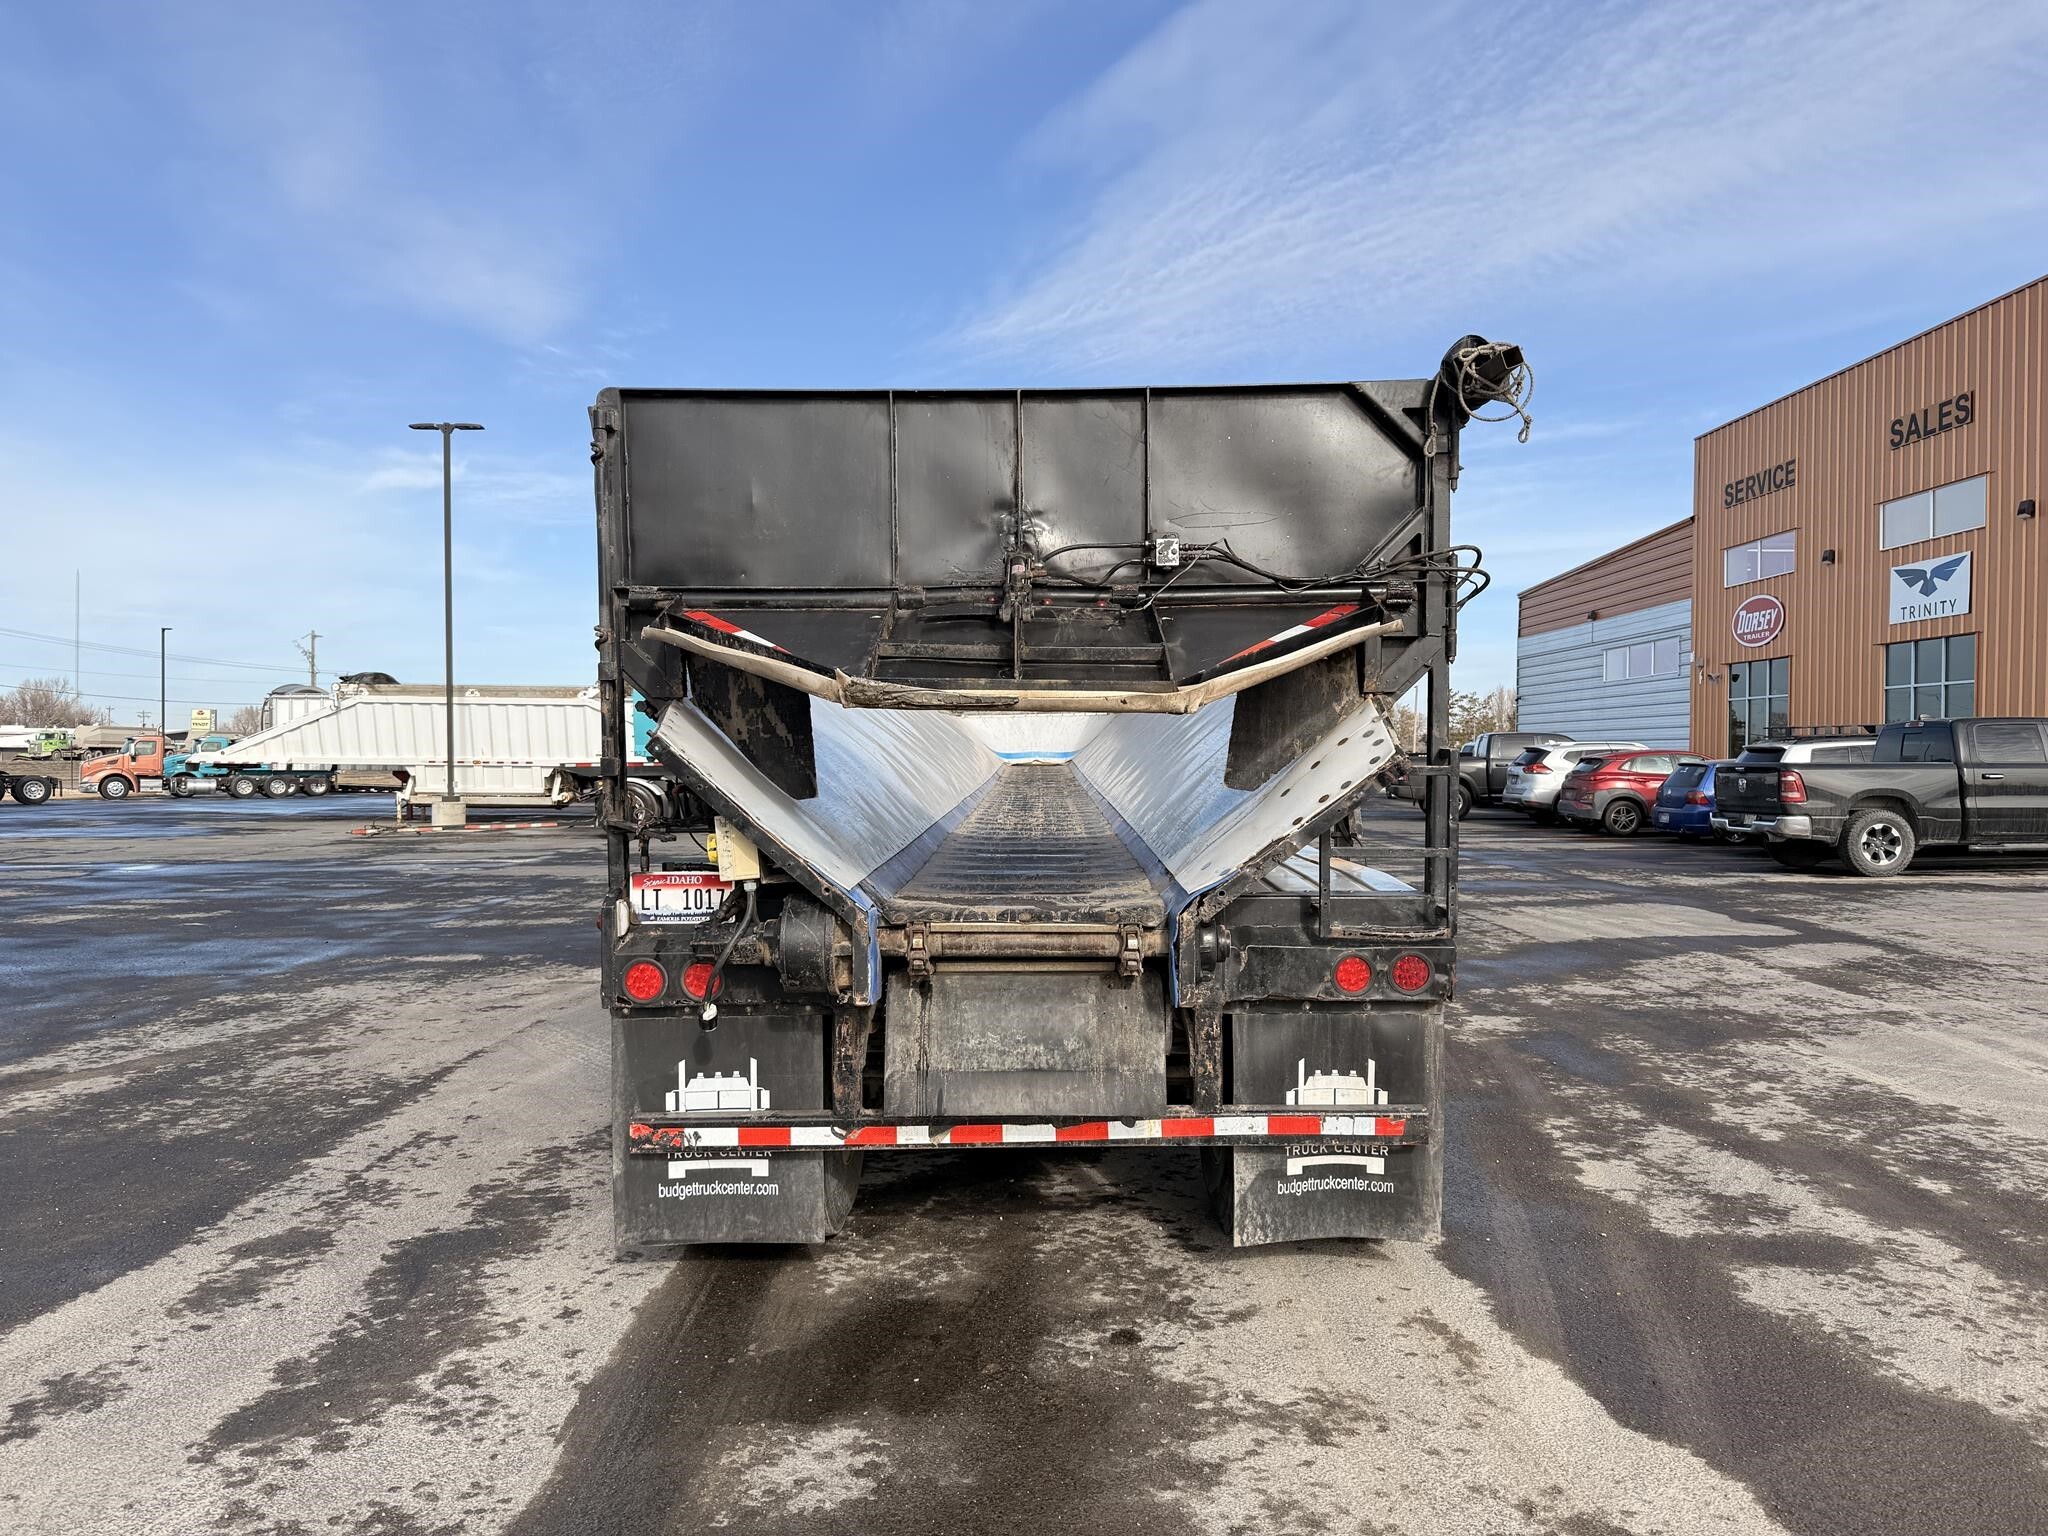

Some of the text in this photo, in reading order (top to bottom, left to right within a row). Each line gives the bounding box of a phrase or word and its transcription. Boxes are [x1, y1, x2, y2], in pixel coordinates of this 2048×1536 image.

[1890, 393, 1970, 448] SALES
[1724, 458, 1796, 507] SERVICE
[1900, 599, 1957, 620] TRINITY
[1736, 607, 1779, 634] DORSEY
[1743, 630, 1770, 641] TRAILER
[667, 876, 702, 884] IDAHO
[641, 889, 725, 910] LT 1017
[1285, 1144, 1389, 1156] TRUCK CENTER
[658, 1180, 779, 1200] budgettruckcenter.com
[1277, 1175, 1394, 1196] budgettruckcenter.com
